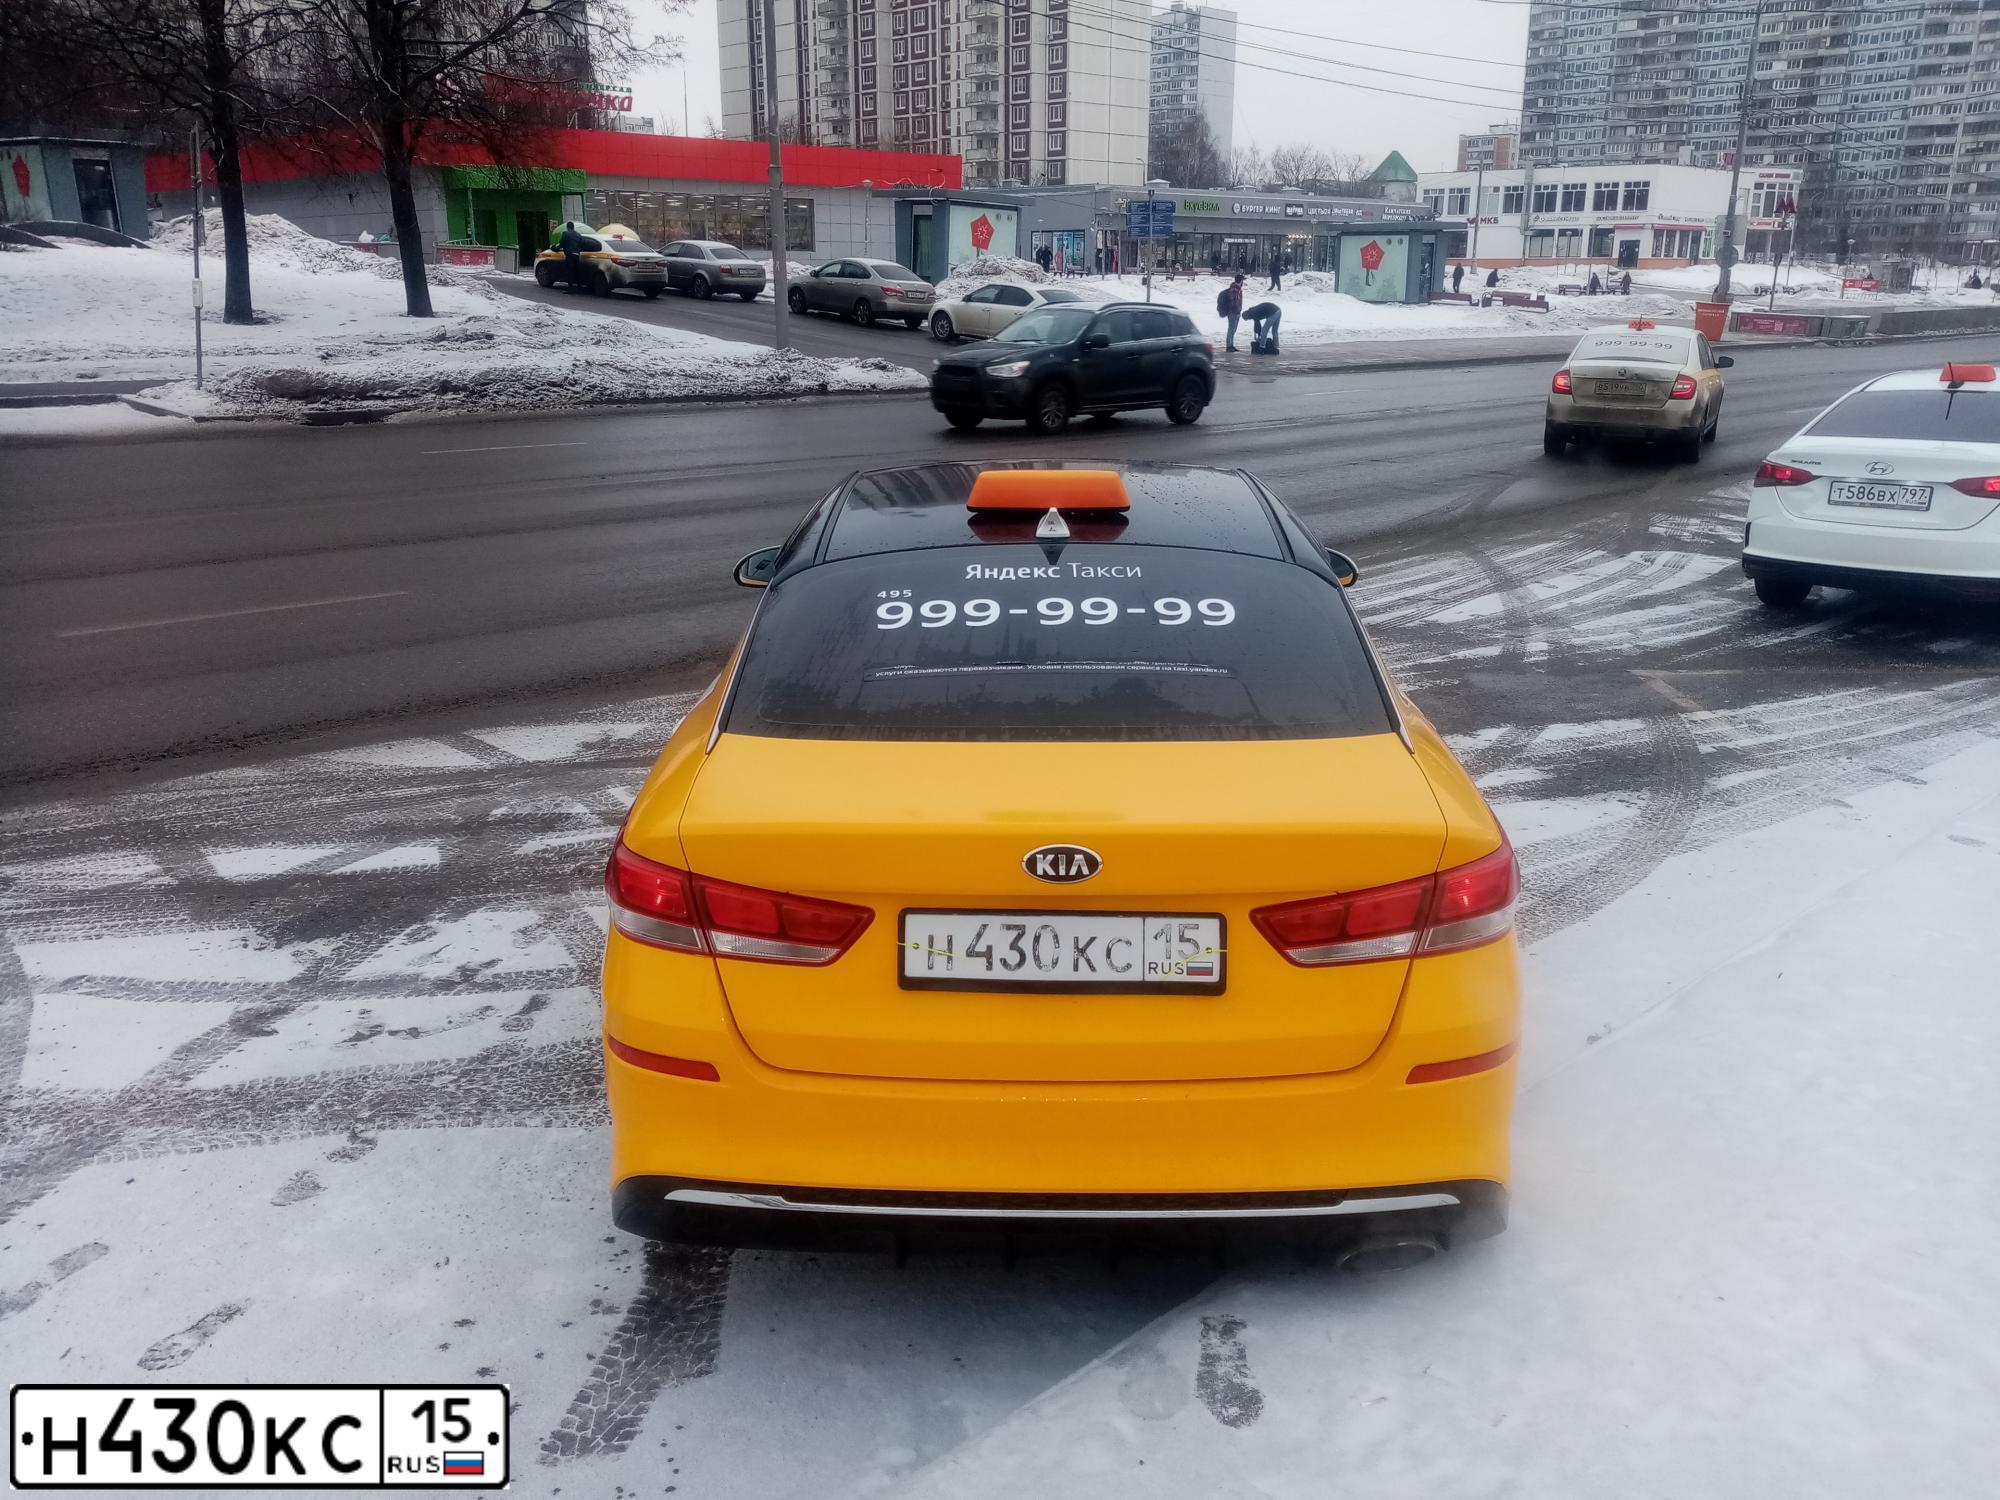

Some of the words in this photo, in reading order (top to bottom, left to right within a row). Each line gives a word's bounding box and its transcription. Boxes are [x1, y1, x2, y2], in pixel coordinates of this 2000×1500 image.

[1479, 216, 1499, 225] МКБ
[1595, 340, 1672, 350] 999-99-99
[1837, 485, 1897, 503] Т586ВХ
[1901, 487, 1925, 500] 797
[965, 563, 1060, 580] Яндекс
[1066, 562, 1142, 579] Такси
[876, 589, 913, 599] 495
[876, 597, 1236, 630] 999-99-99
[875, 669, 903, 678] услуги
[1172, 666, 1228, 674] taxi.yandex.ru
[1035, 854, 1090, 876] KIA
[927, 923, 1133, 974] Н430КС
[1153, 923, 1201, 960] 15
[1148, 961, 1184, 975] RUS
